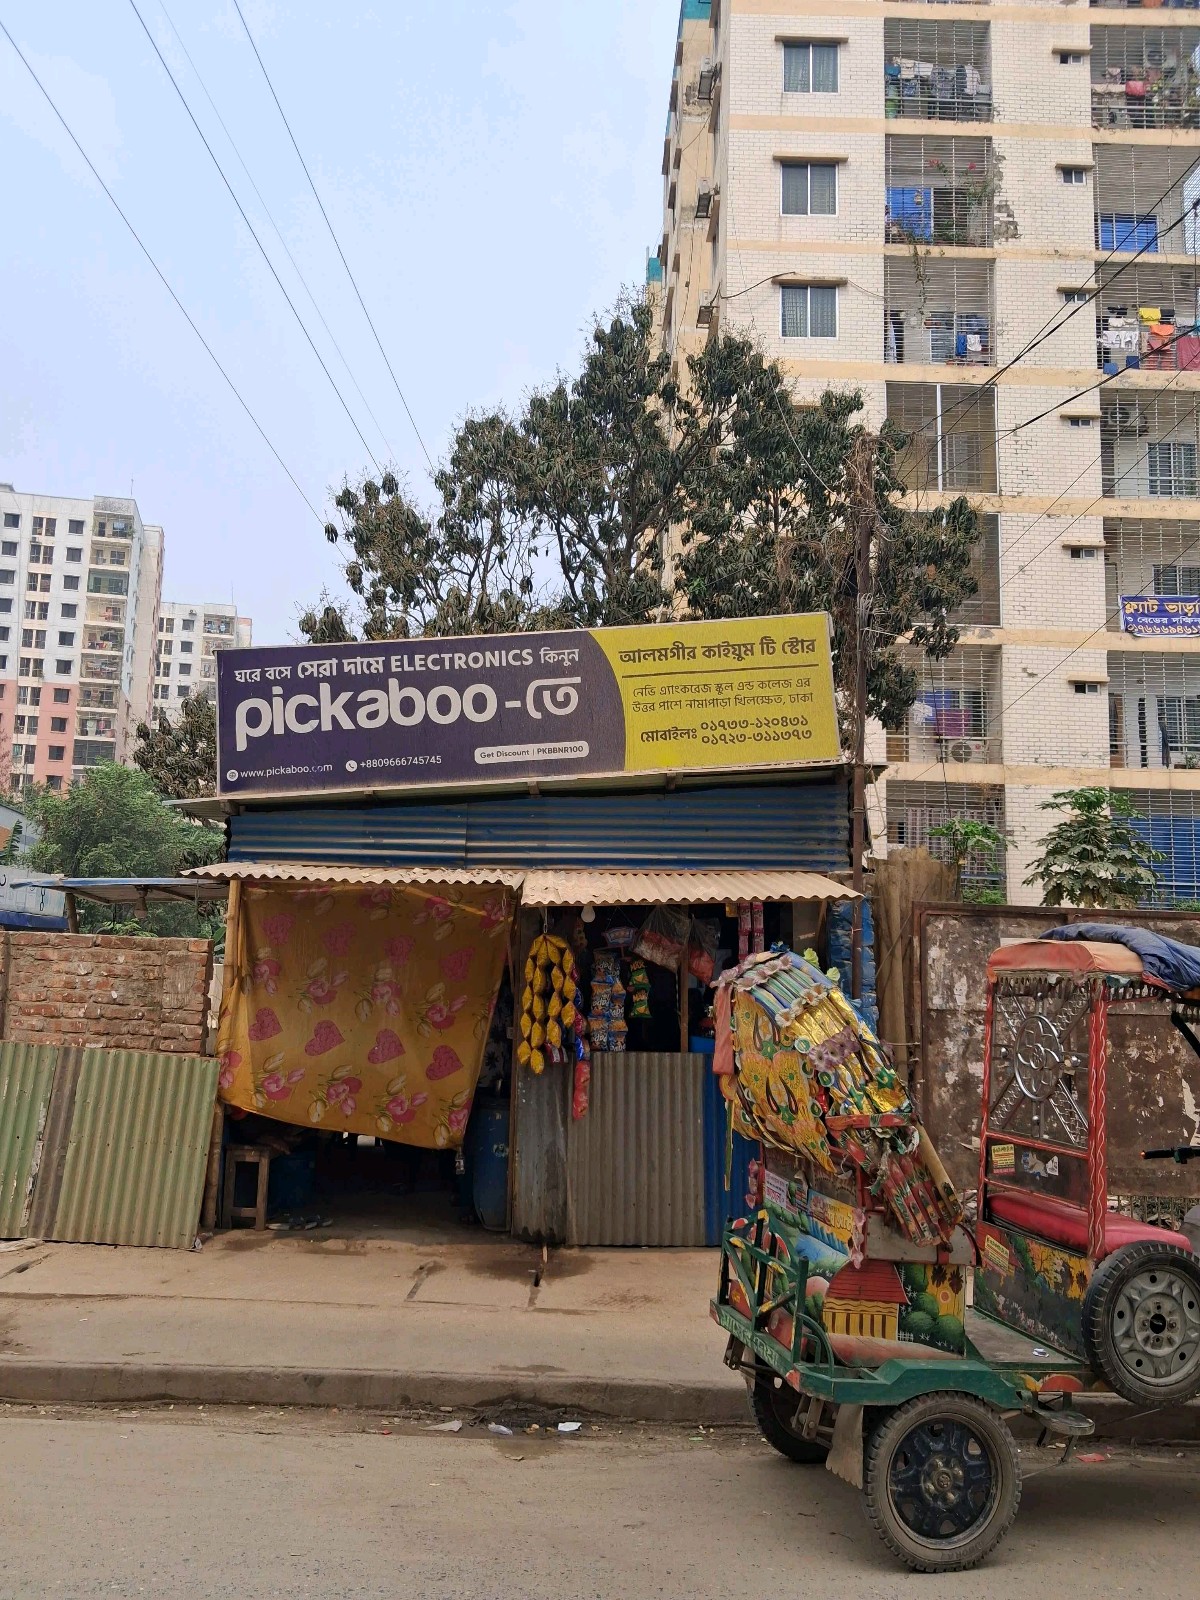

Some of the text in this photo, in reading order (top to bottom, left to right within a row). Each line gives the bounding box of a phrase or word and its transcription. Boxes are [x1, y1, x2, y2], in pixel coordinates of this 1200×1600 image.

[1127, 624, 1200, 633] ০১৭৬৬৬৯৪৬১
[618, 635, 817, 663] আলমগীর কাইয়ুম টি স্টোর
[234, 646, 580, 683] ঘরে বসে সেরা দামে ELECTRONICS কিনুন
[633, 685, 656, 698] নেভি
[714, 682, 734, 696] স্কুল
[736, 681, 755, 691] এন্ড
[757, 679, 792, 690] কলেজ
[795, 677, 811, 688] এর
[632, 701, 655, 713] উত্তর
[658, 699, 682, 711] পাশে
[788, 692, 814, 703] ঢাকা
[235, 677, 498, 752] pickaboo
[700, 714, 808, 731] ০১৭৩৩-১২০৪৩১
[701, 729, 812, 745] ০১৭২৩-৩১১৩৭৩
[480, 745, 584, 759] Get Discount PKBBNR100
[360, 755, 442, 768] +8809666745745
[240, 764, 333, 778] www.pickaboo.com
